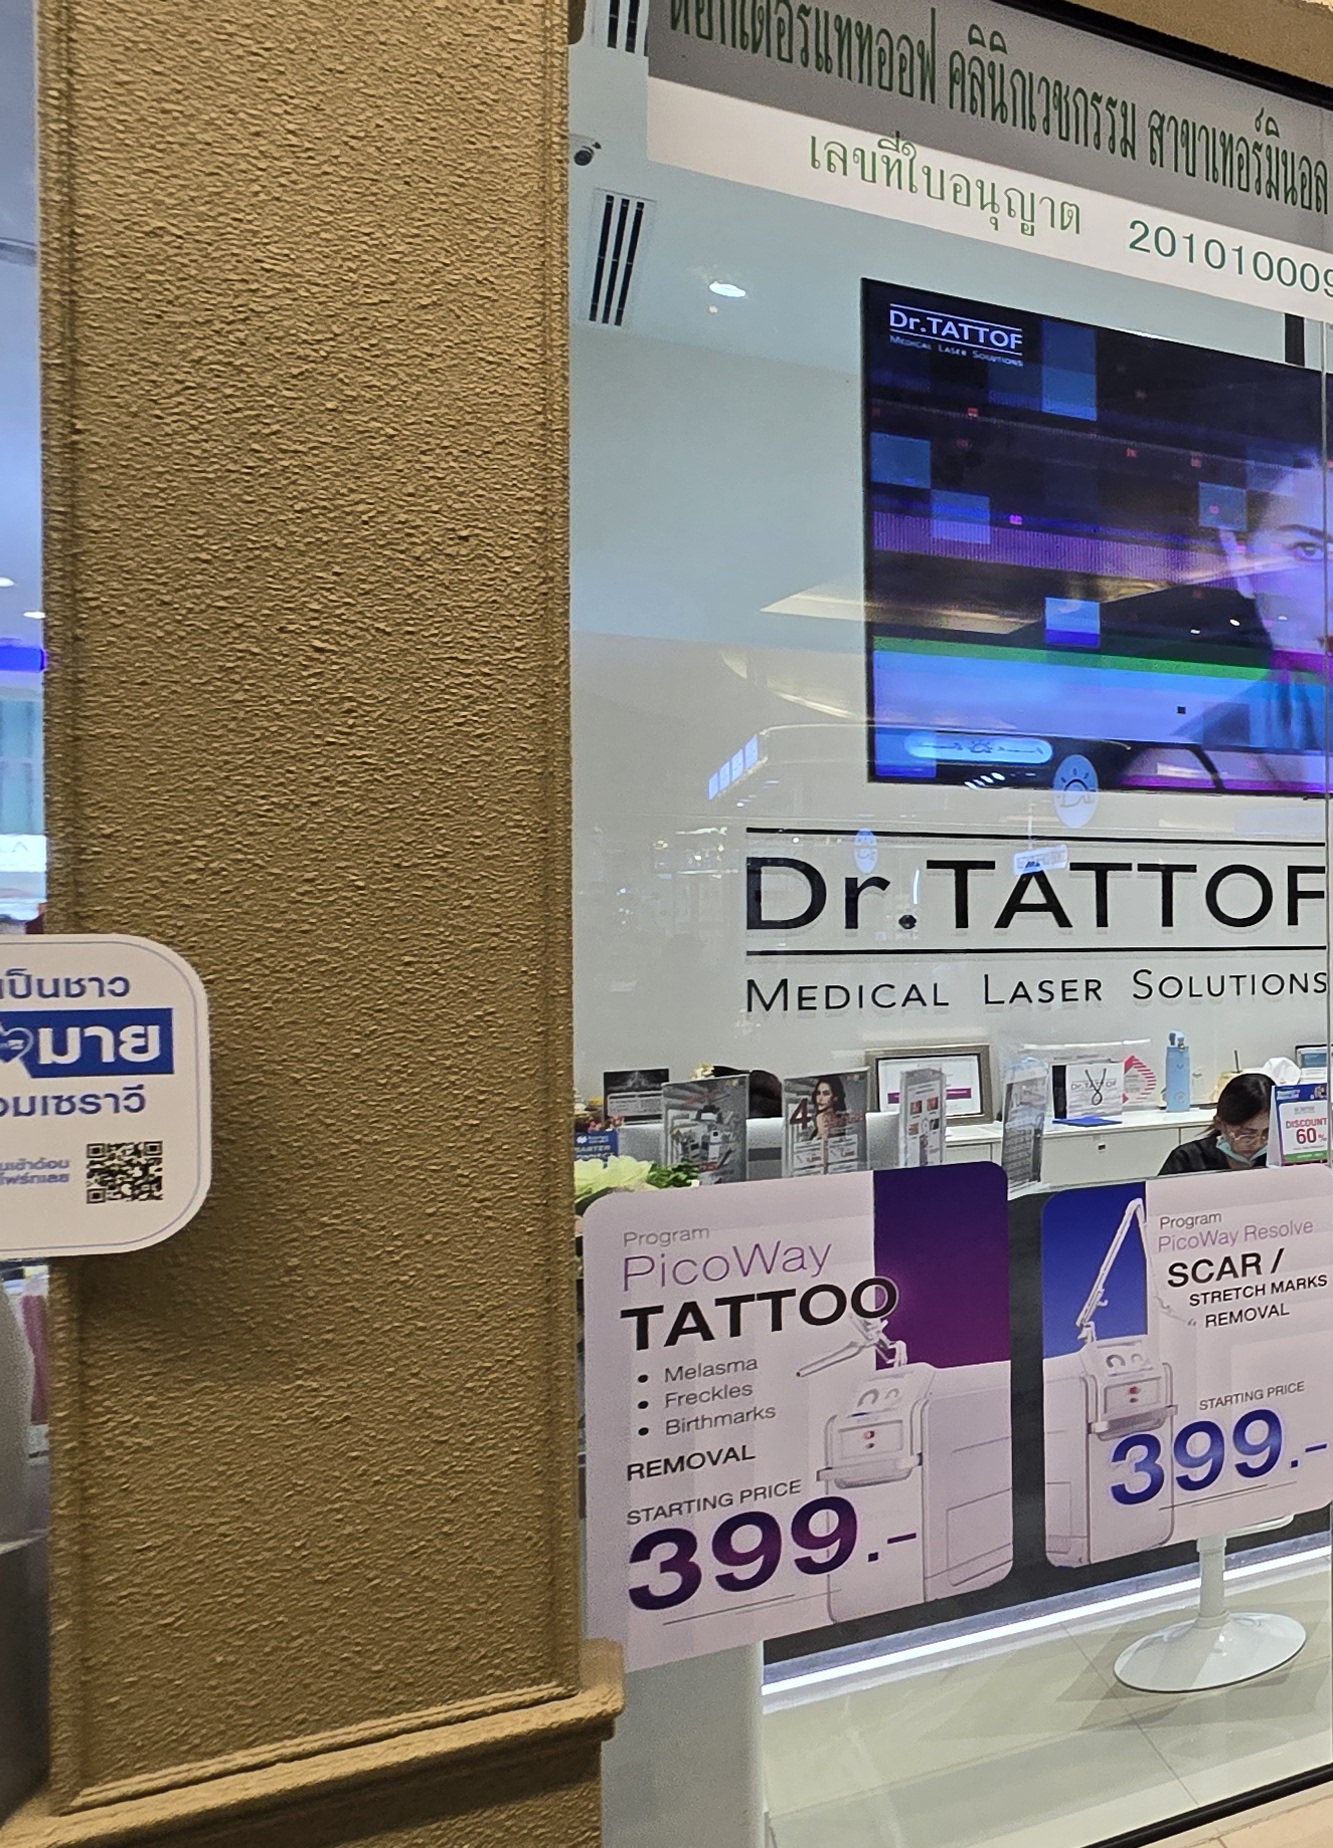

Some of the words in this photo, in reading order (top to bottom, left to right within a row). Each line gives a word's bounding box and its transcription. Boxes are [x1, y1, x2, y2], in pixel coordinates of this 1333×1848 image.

[948, 23, 1137, 160] คลินิกเวชกรรม
[1148, 107, 1329, 215] สาขาเทอร์มินอล
[810, 131, 1081, 237] เลขที่ใบอนุญาต
[889, 309, 1023, 349] Dr.TATTOF
[938, 344, 967, 357] LASER
[746, 856, 1327, 931] Dr.TATTOF
[747, 977, 949, 1013] MEDICAL
[984, 973, 1102, 1005] LASER
[1133, 968, 1328, 1001] SOLUTIONS
[1285, 1117, 1328, 1129] DISCOUNT
[1296, 1127, 1317, 1145] 60
[623, 1226, 711, 1248] Program
[1158, 1229, 1239, 1253] PicoWay
[1244, 1218, 1314, 1242] Resolve
[1159, 1211, 1222, 1230] Program
[623, 1240, 832, 1292] PicoWay
[1167, 1251, 1263, 1289] SCAR
[1189, 1283, 1267, 1307] STRETCH
[1270, 1275, 1328, 1295] MARKS
[620, 1276, 898, 1352] TATTOO
[1205, 1302, 1290, 1328] REMOVAL
[664, 1356, 759, 1384] Melasma
[665, 1383, 753, 1409] Freckles
[1199, 1389, 1264, 1411] STARTING
[1267, 1381, 1305, 1401] PRICE
[665, 1405, 776, 1437] Birthmarks
[627, 1445, 756, 1481] REMOVAL
[1110, 1408, 1328, 1506] 399.-
[626, 1493, 734, 1526] STARTING
[739, 1479, 802, 1508] PRICE
[628, 1495, 917, 1612] 399.-
